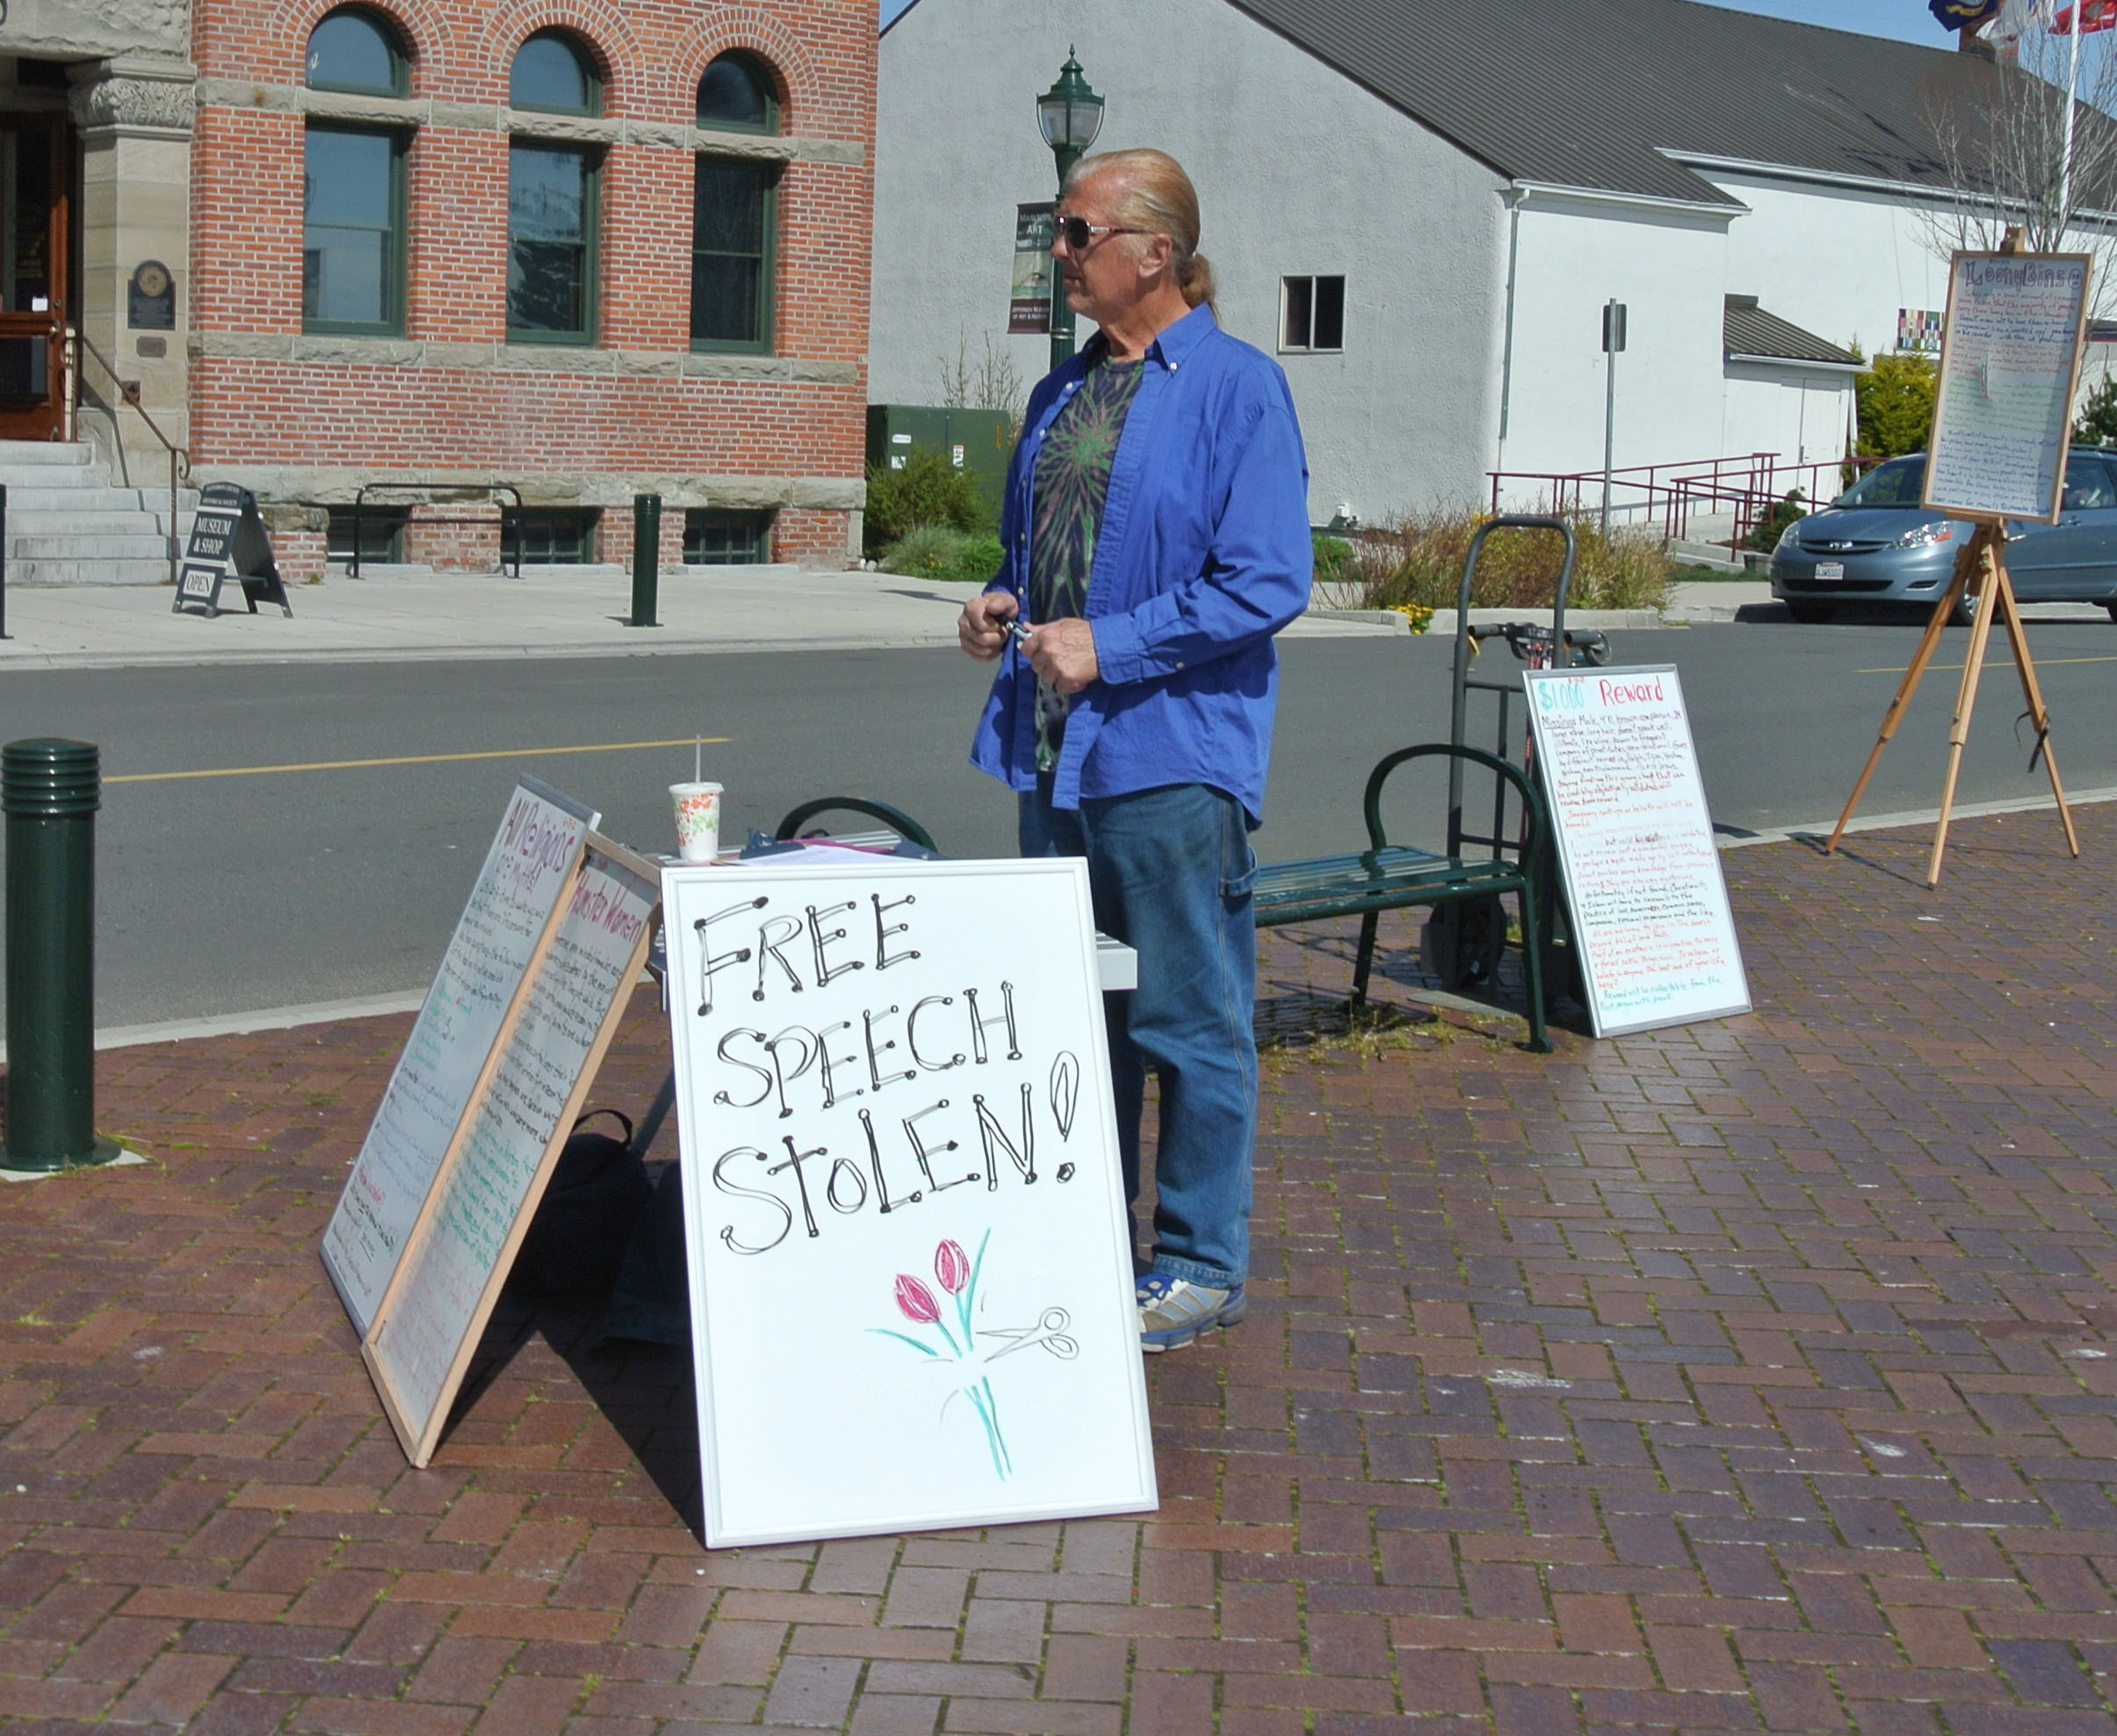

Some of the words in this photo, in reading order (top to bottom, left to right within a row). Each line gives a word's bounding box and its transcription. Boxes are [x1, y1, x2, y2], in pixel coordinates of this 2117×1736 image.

[1027, 225, 1043, 235] ART
[196, 517, 232, 536] MUSEUM
[193, 538, 200, 553] &
[201, 539, 223, 555] SHOP
[186, 574, 212, 593] OPEN
[1599, 675, 1664, 706] Reward
[694, 893, 921, 1016] FREE
[714, 980, 1022, 1118] SPEECH
